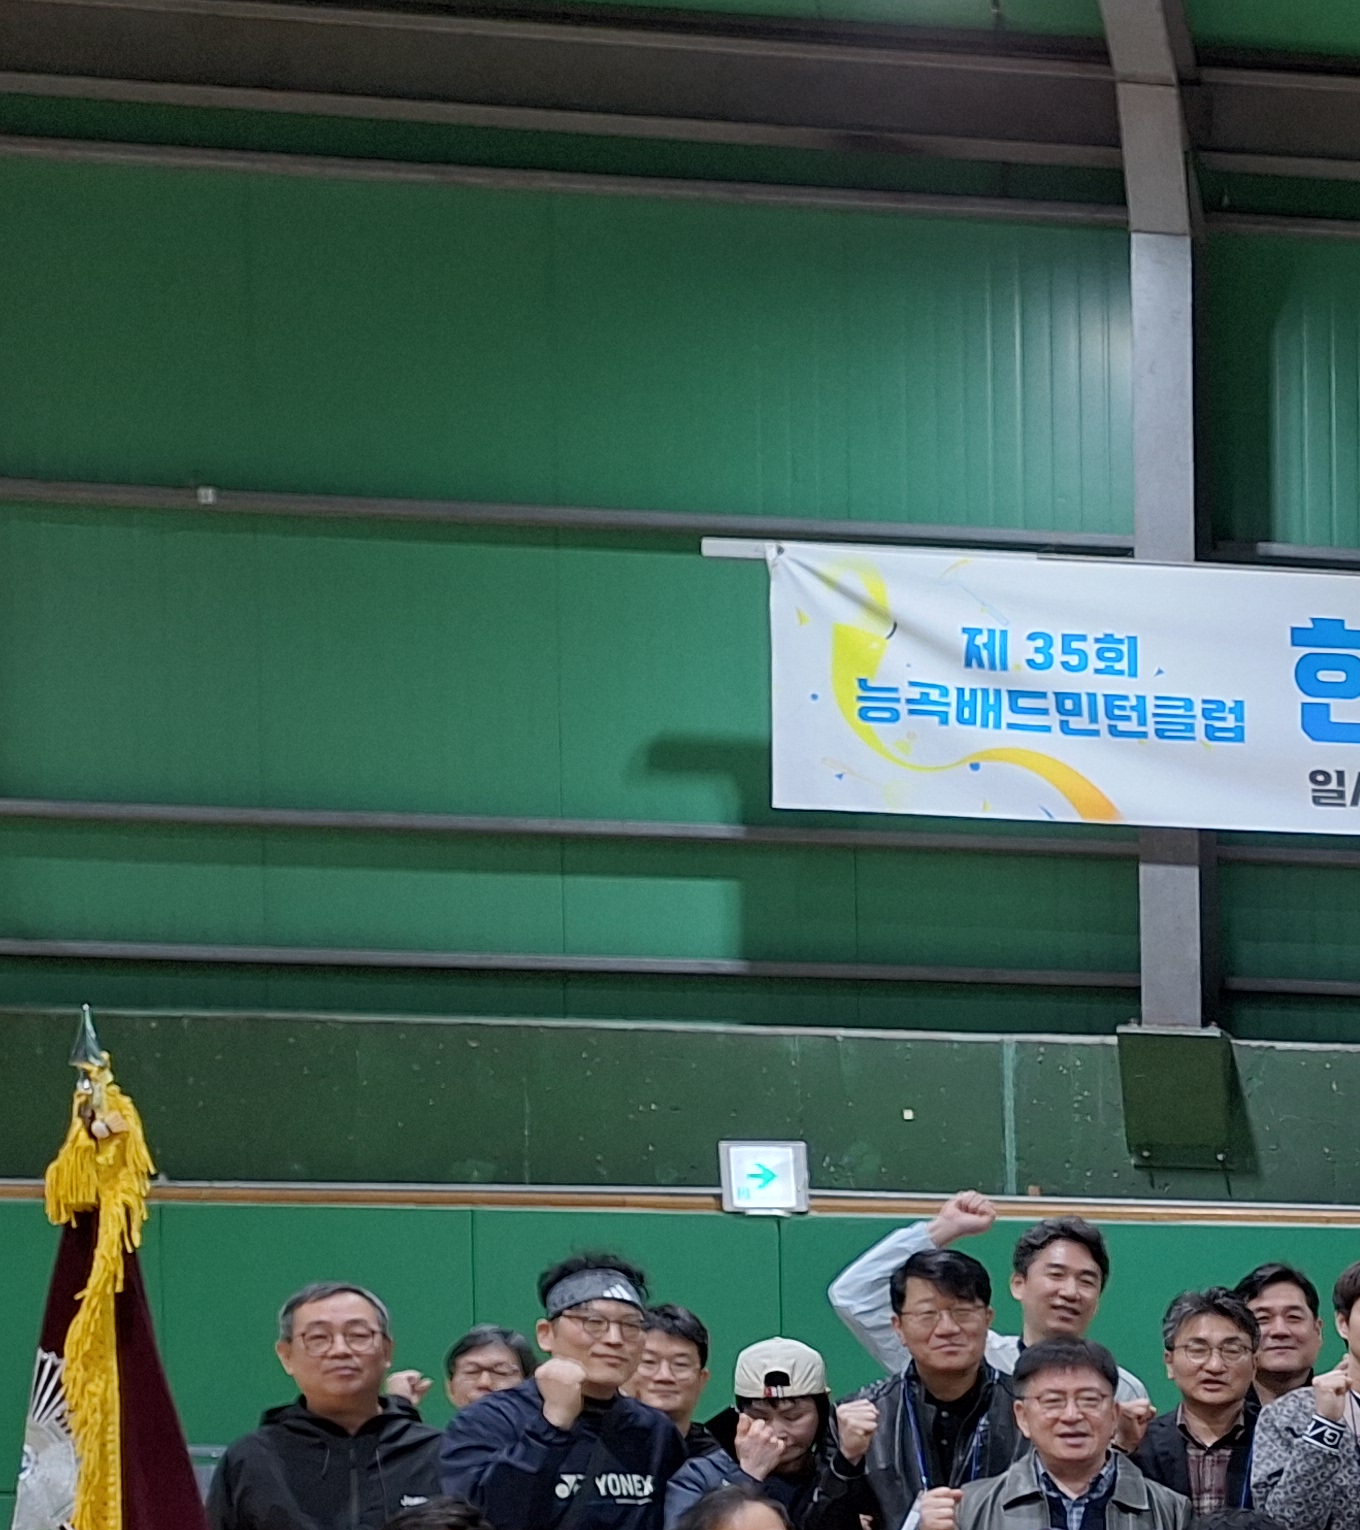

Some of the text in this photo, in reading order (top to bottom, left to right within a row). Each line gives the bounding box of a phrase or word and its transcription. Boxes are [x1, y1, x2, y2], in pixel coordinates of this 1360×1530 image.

[960, 624, 1141, 679] 제 35회
[855, 674, 1248, 745] 능곡배드민턴클럽
[595, 1473, 654, 1497] YONEX
